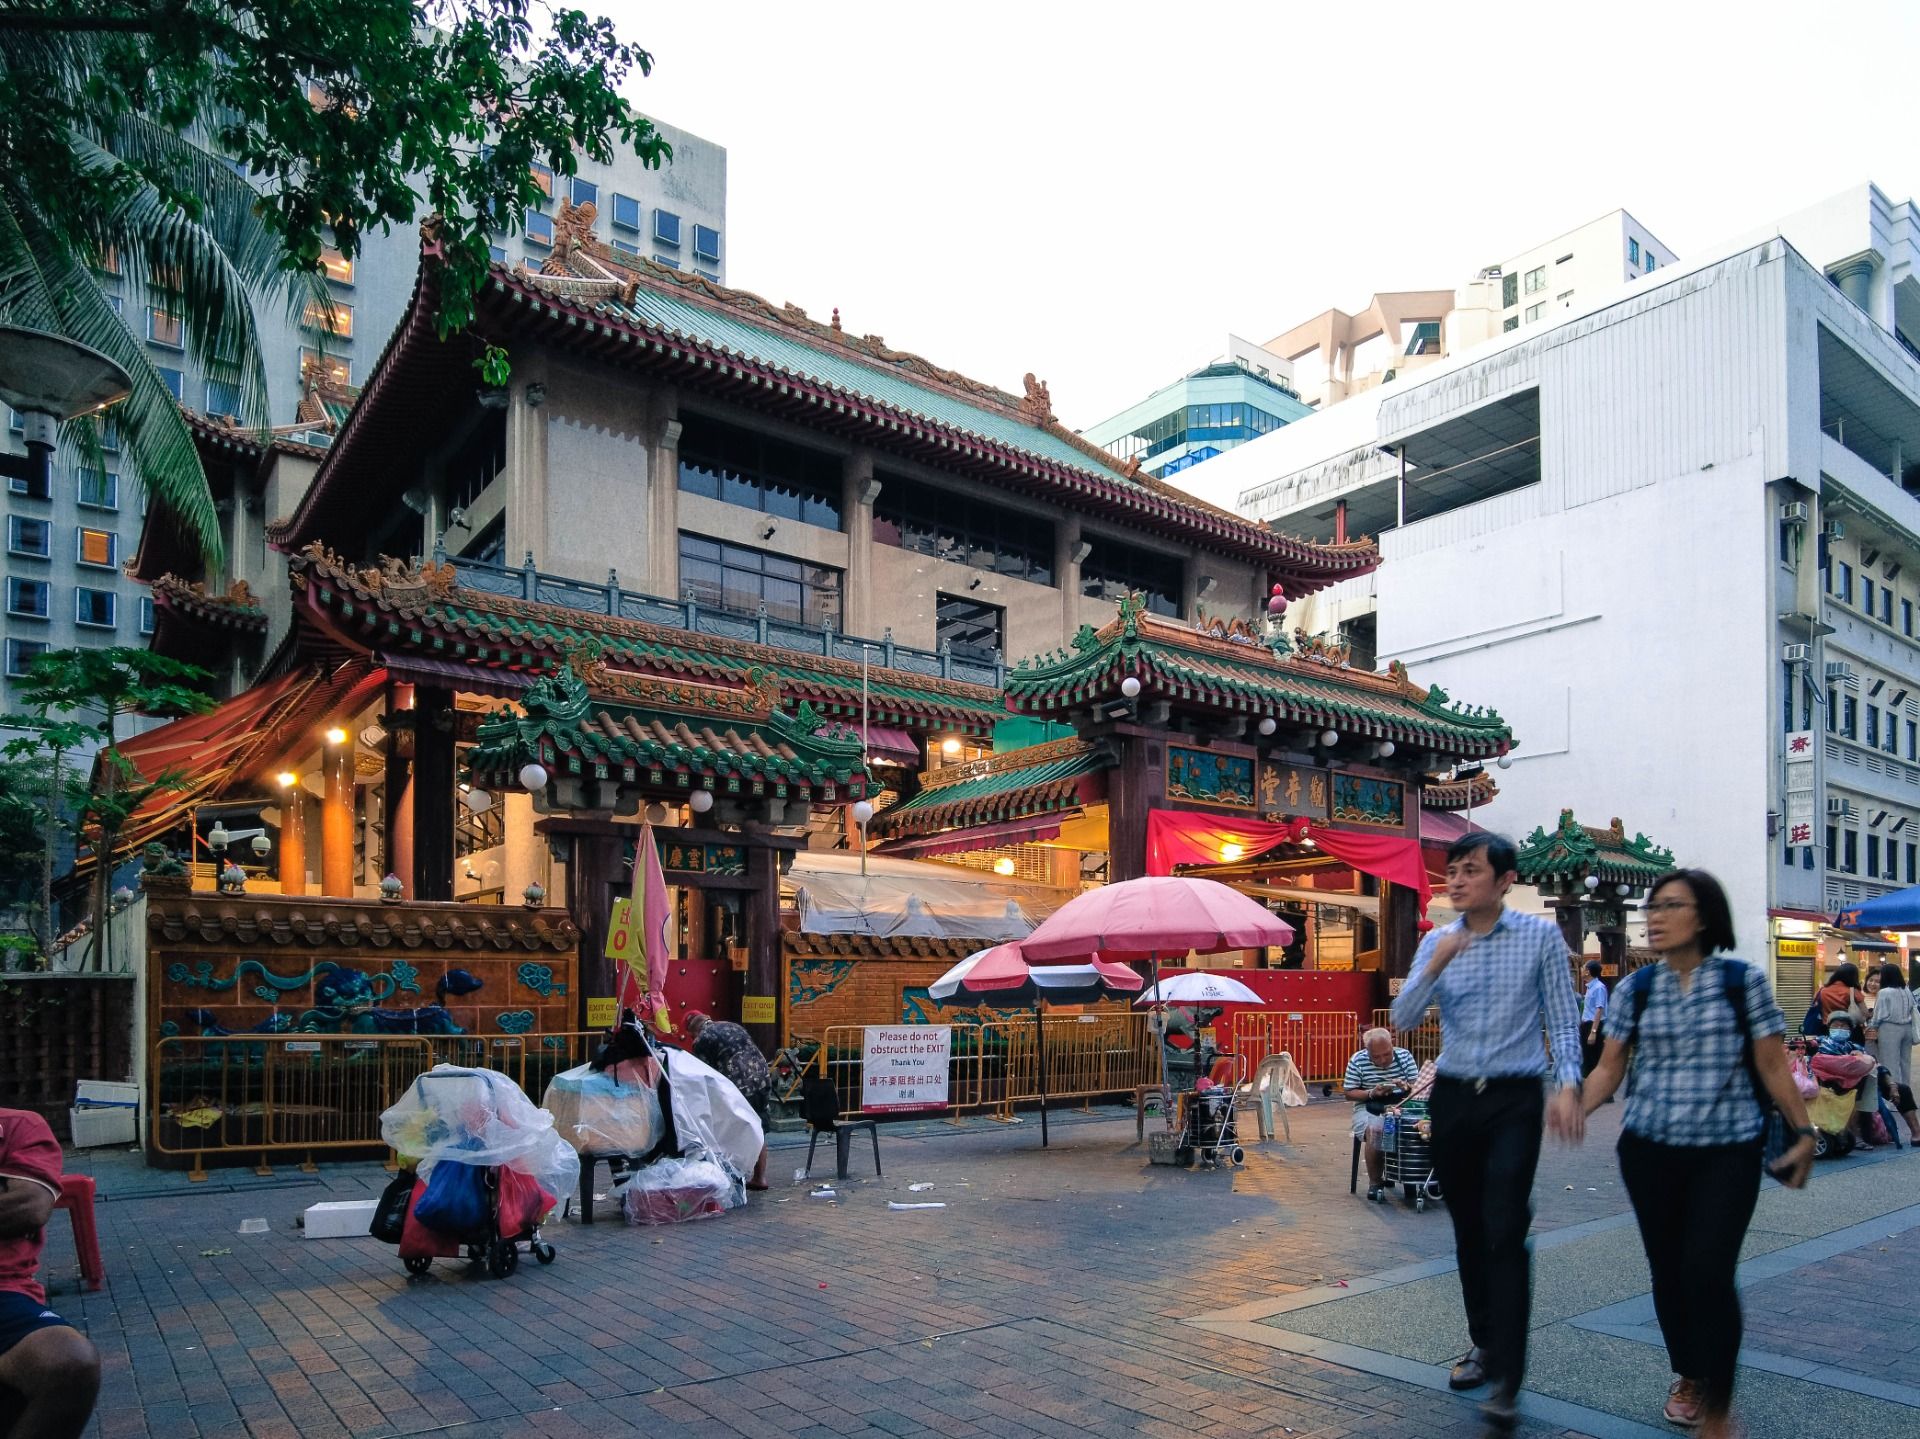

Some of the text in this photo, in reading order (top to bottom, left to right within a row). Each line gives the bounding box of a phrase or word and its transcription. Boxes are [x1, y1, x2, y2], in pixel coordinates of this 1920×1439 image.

[759, 1001, 774, 1009] ONLY
[879, 1032, 938, 1041] Please do not
[870, 1044, 945, 1054] obstruct the EXIT
[869, 1075, 942, 1086] 请不要阻挡出口处
